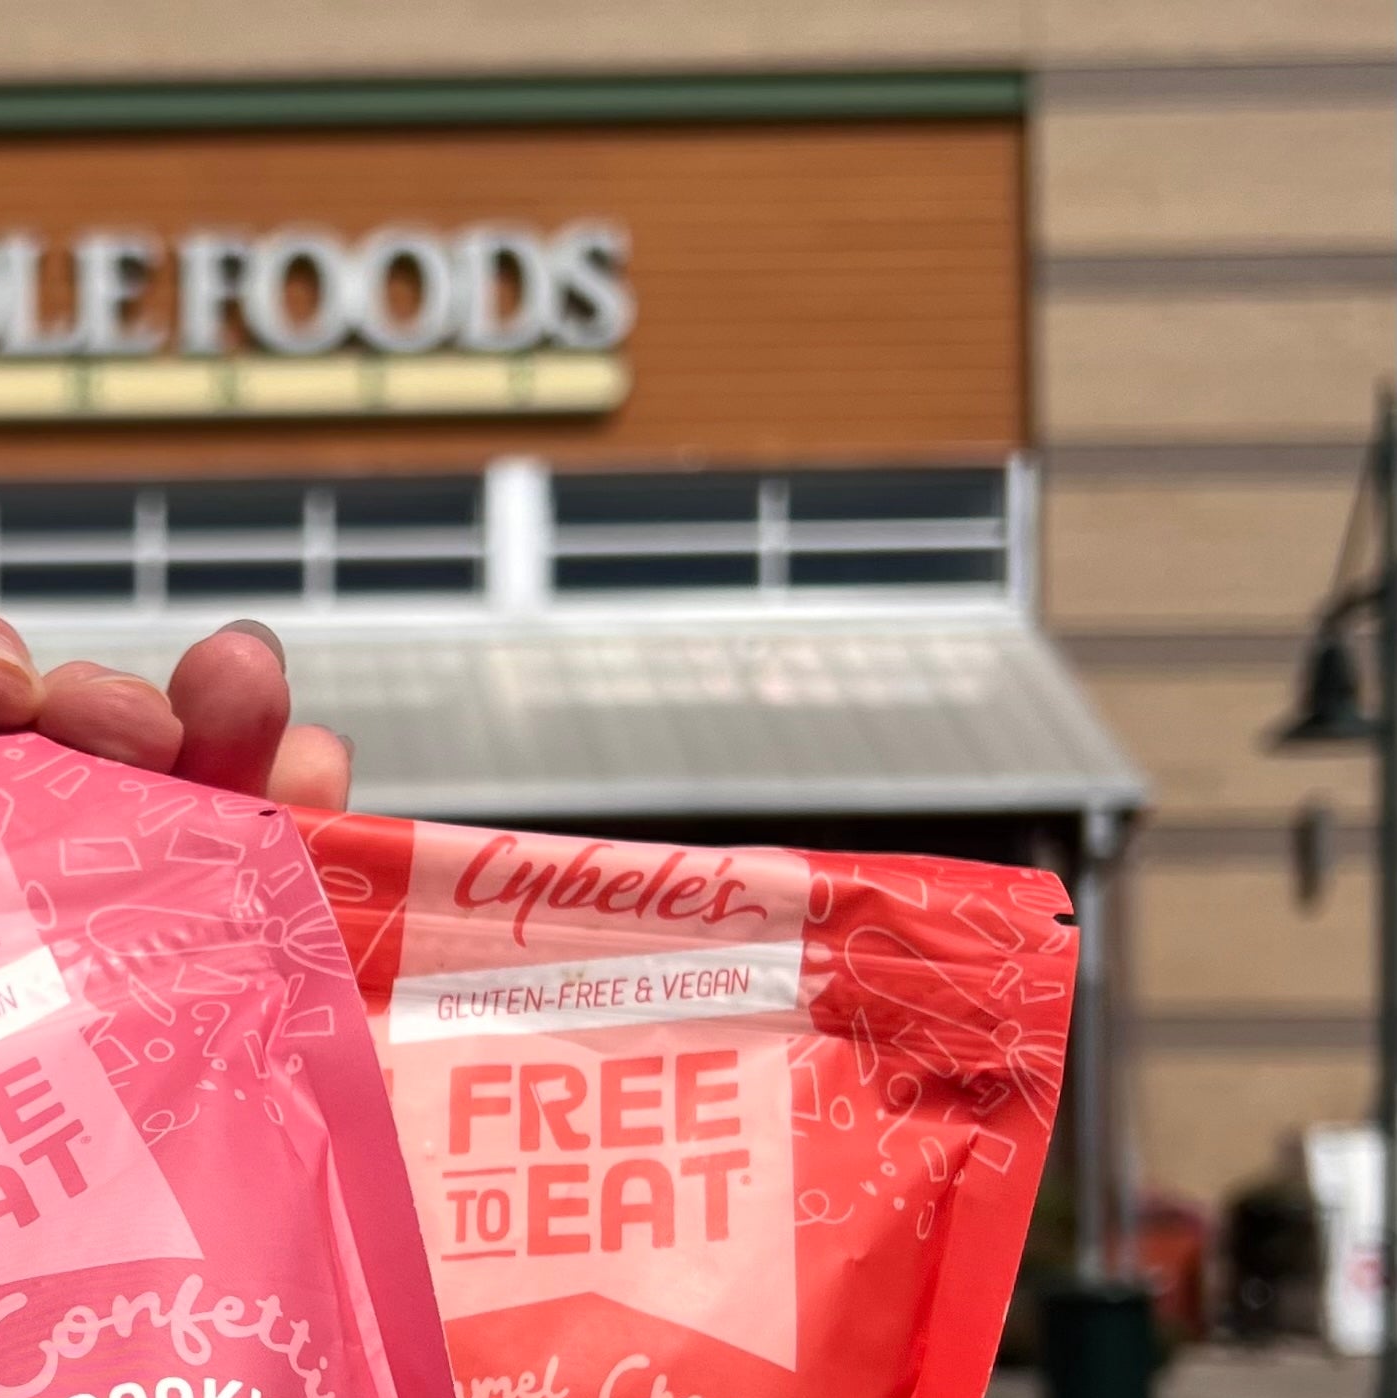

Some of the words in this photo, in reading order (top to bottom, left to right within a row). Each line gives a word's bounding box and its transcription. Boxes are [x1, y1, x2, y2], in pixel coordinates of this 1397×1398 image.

[179, 217, 633, 354] FOODS
[454, 834, 768, 948] Cybele's
[437, 977, 626, 1020] GLUTEN-FREE
[634, 974, 653, 1003] &
[662, 967, 751, 999] VEGAN
[449, 1050, 742, 1155] FREE
[446, 1188, 511, 1243] TO
[527, 1149, 751, 1257] EAT
